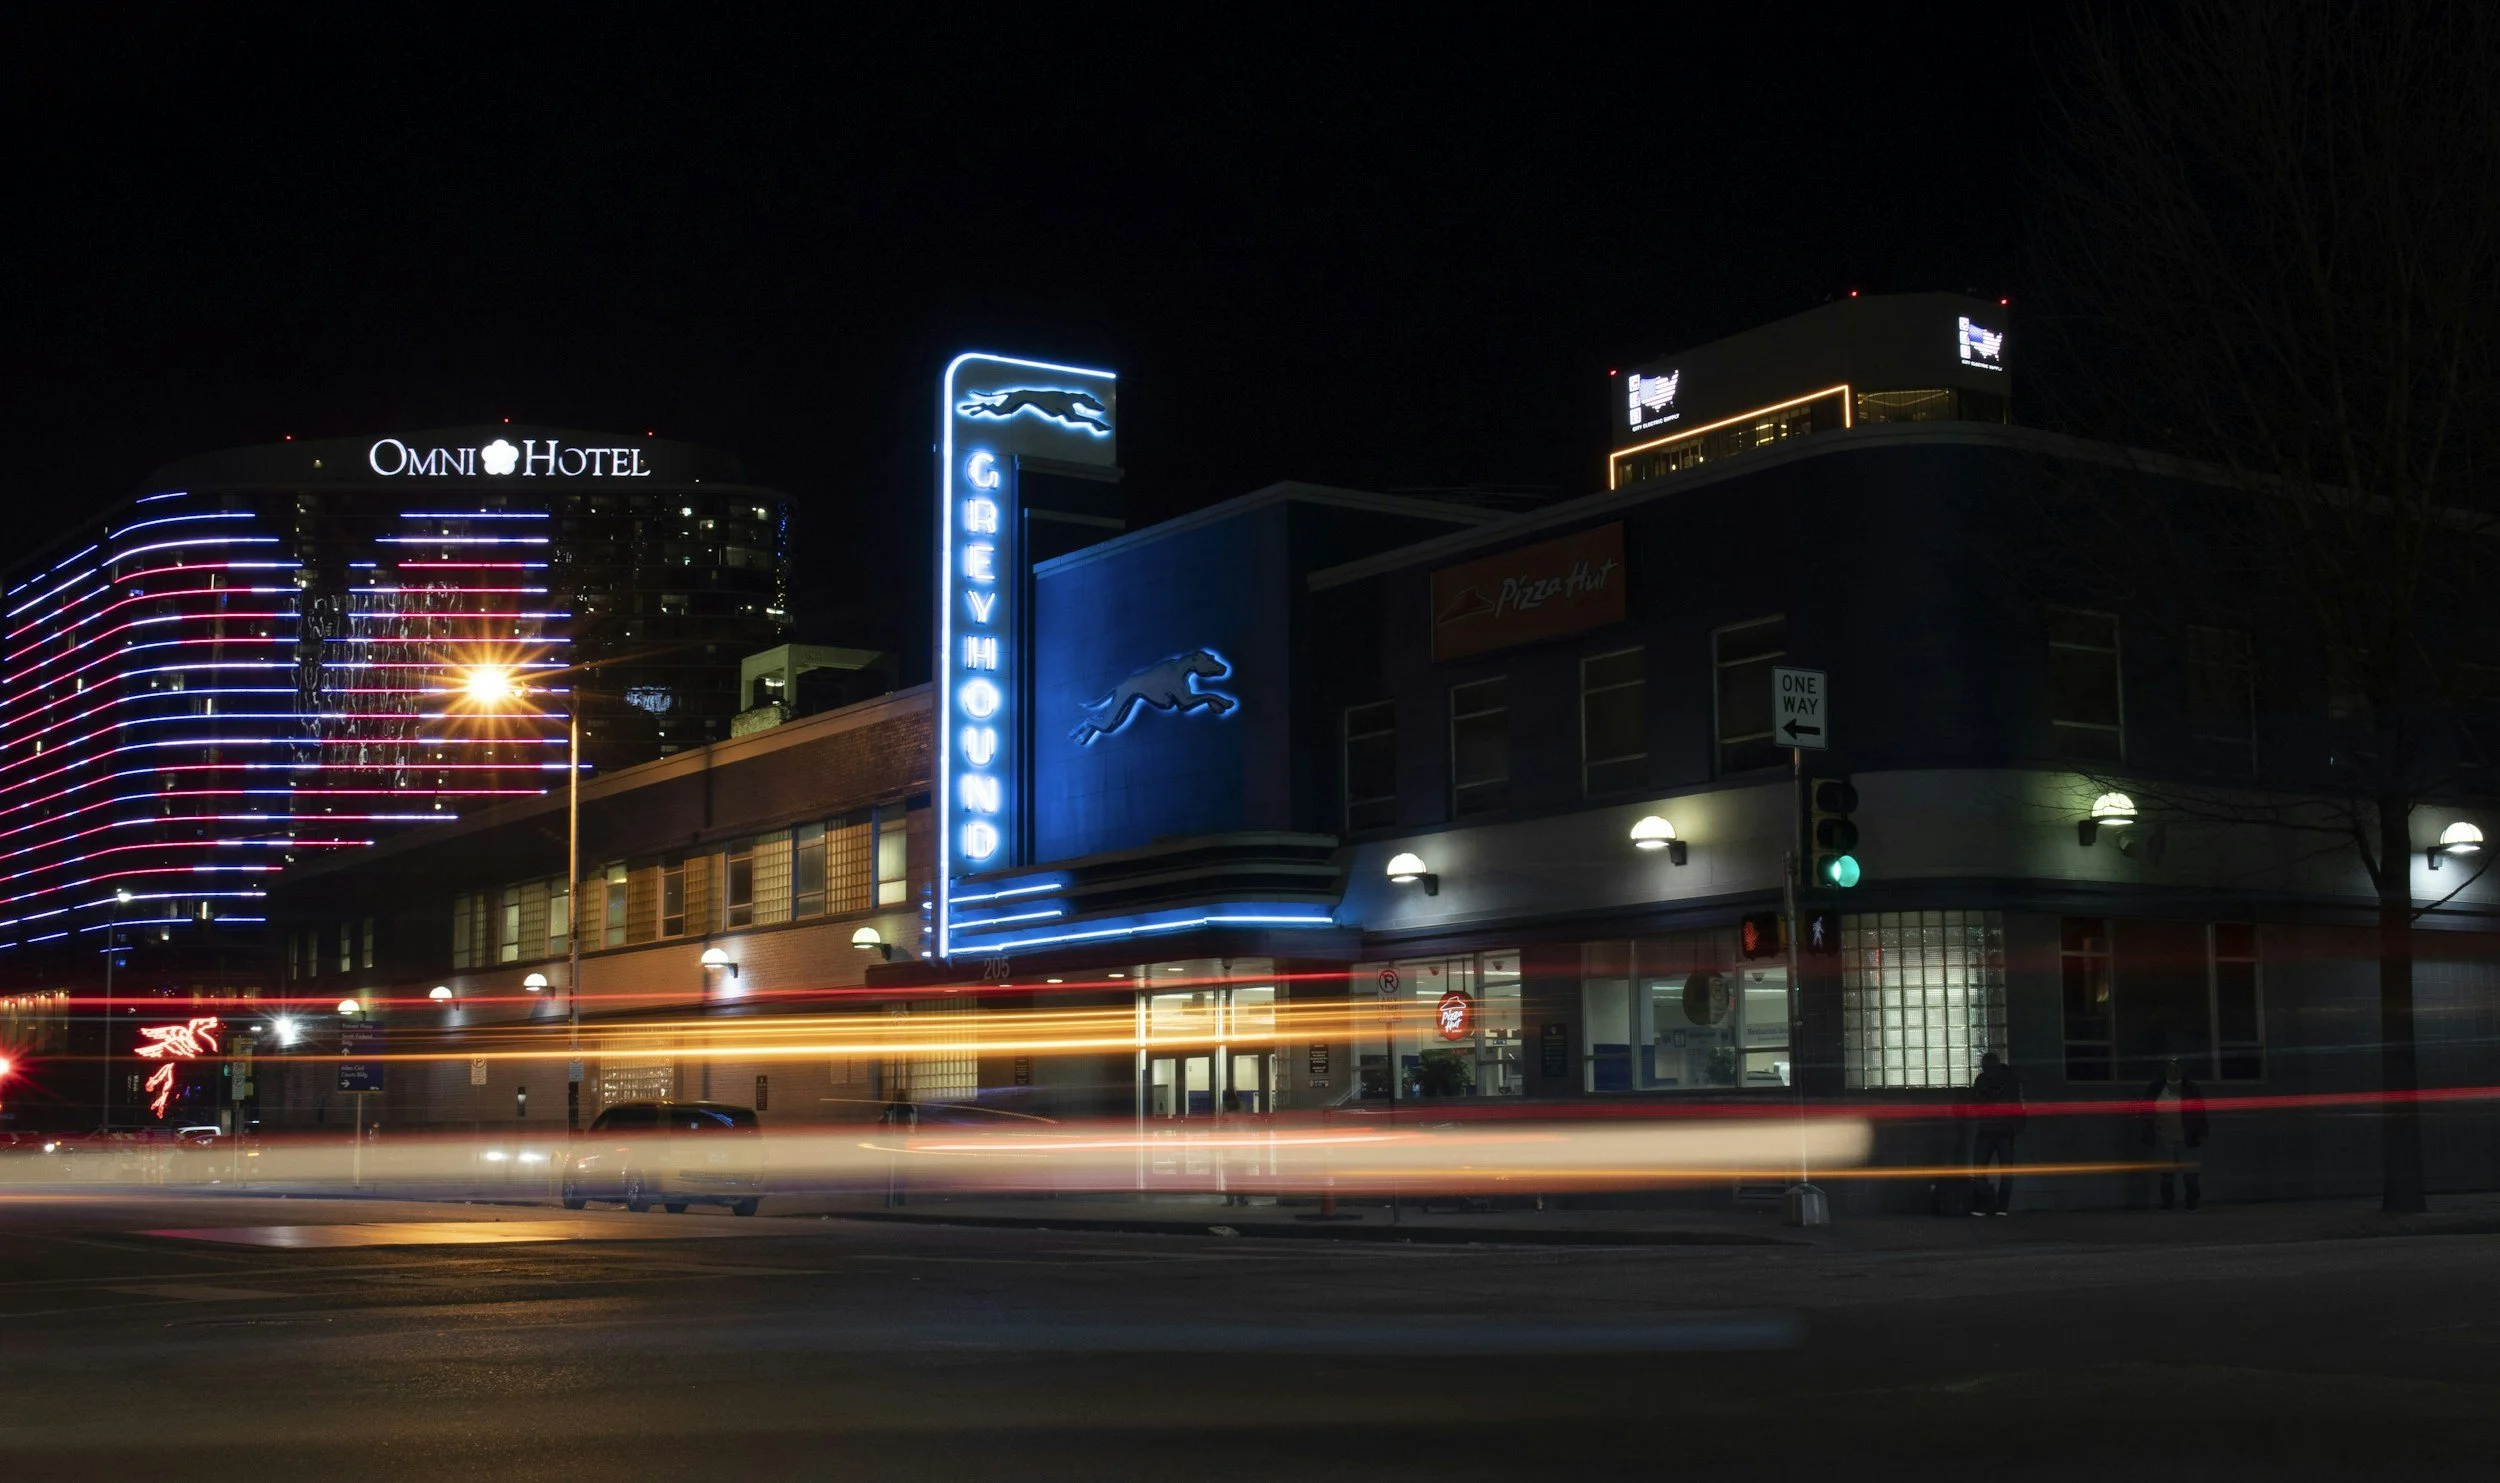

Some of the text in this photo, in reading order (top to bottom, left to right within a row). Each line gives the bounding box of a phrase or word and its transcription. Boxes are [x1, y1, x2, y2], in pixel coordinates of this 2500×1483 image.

[369, 438, 651, 476] OMNI HOTEL
[1494, 557, 1620, 619] Pizza Hut
[964, 451, 1000, 861] GREYHOUND
[1782, 674, 1817, 695] ONE
[1783, 695, 1818, 716] WAY
[984, 957, 1011, 980] 205
[1441, 1009, 1464, 1026] Pizza
[1445, 1018, 1463, 1033] Hut
